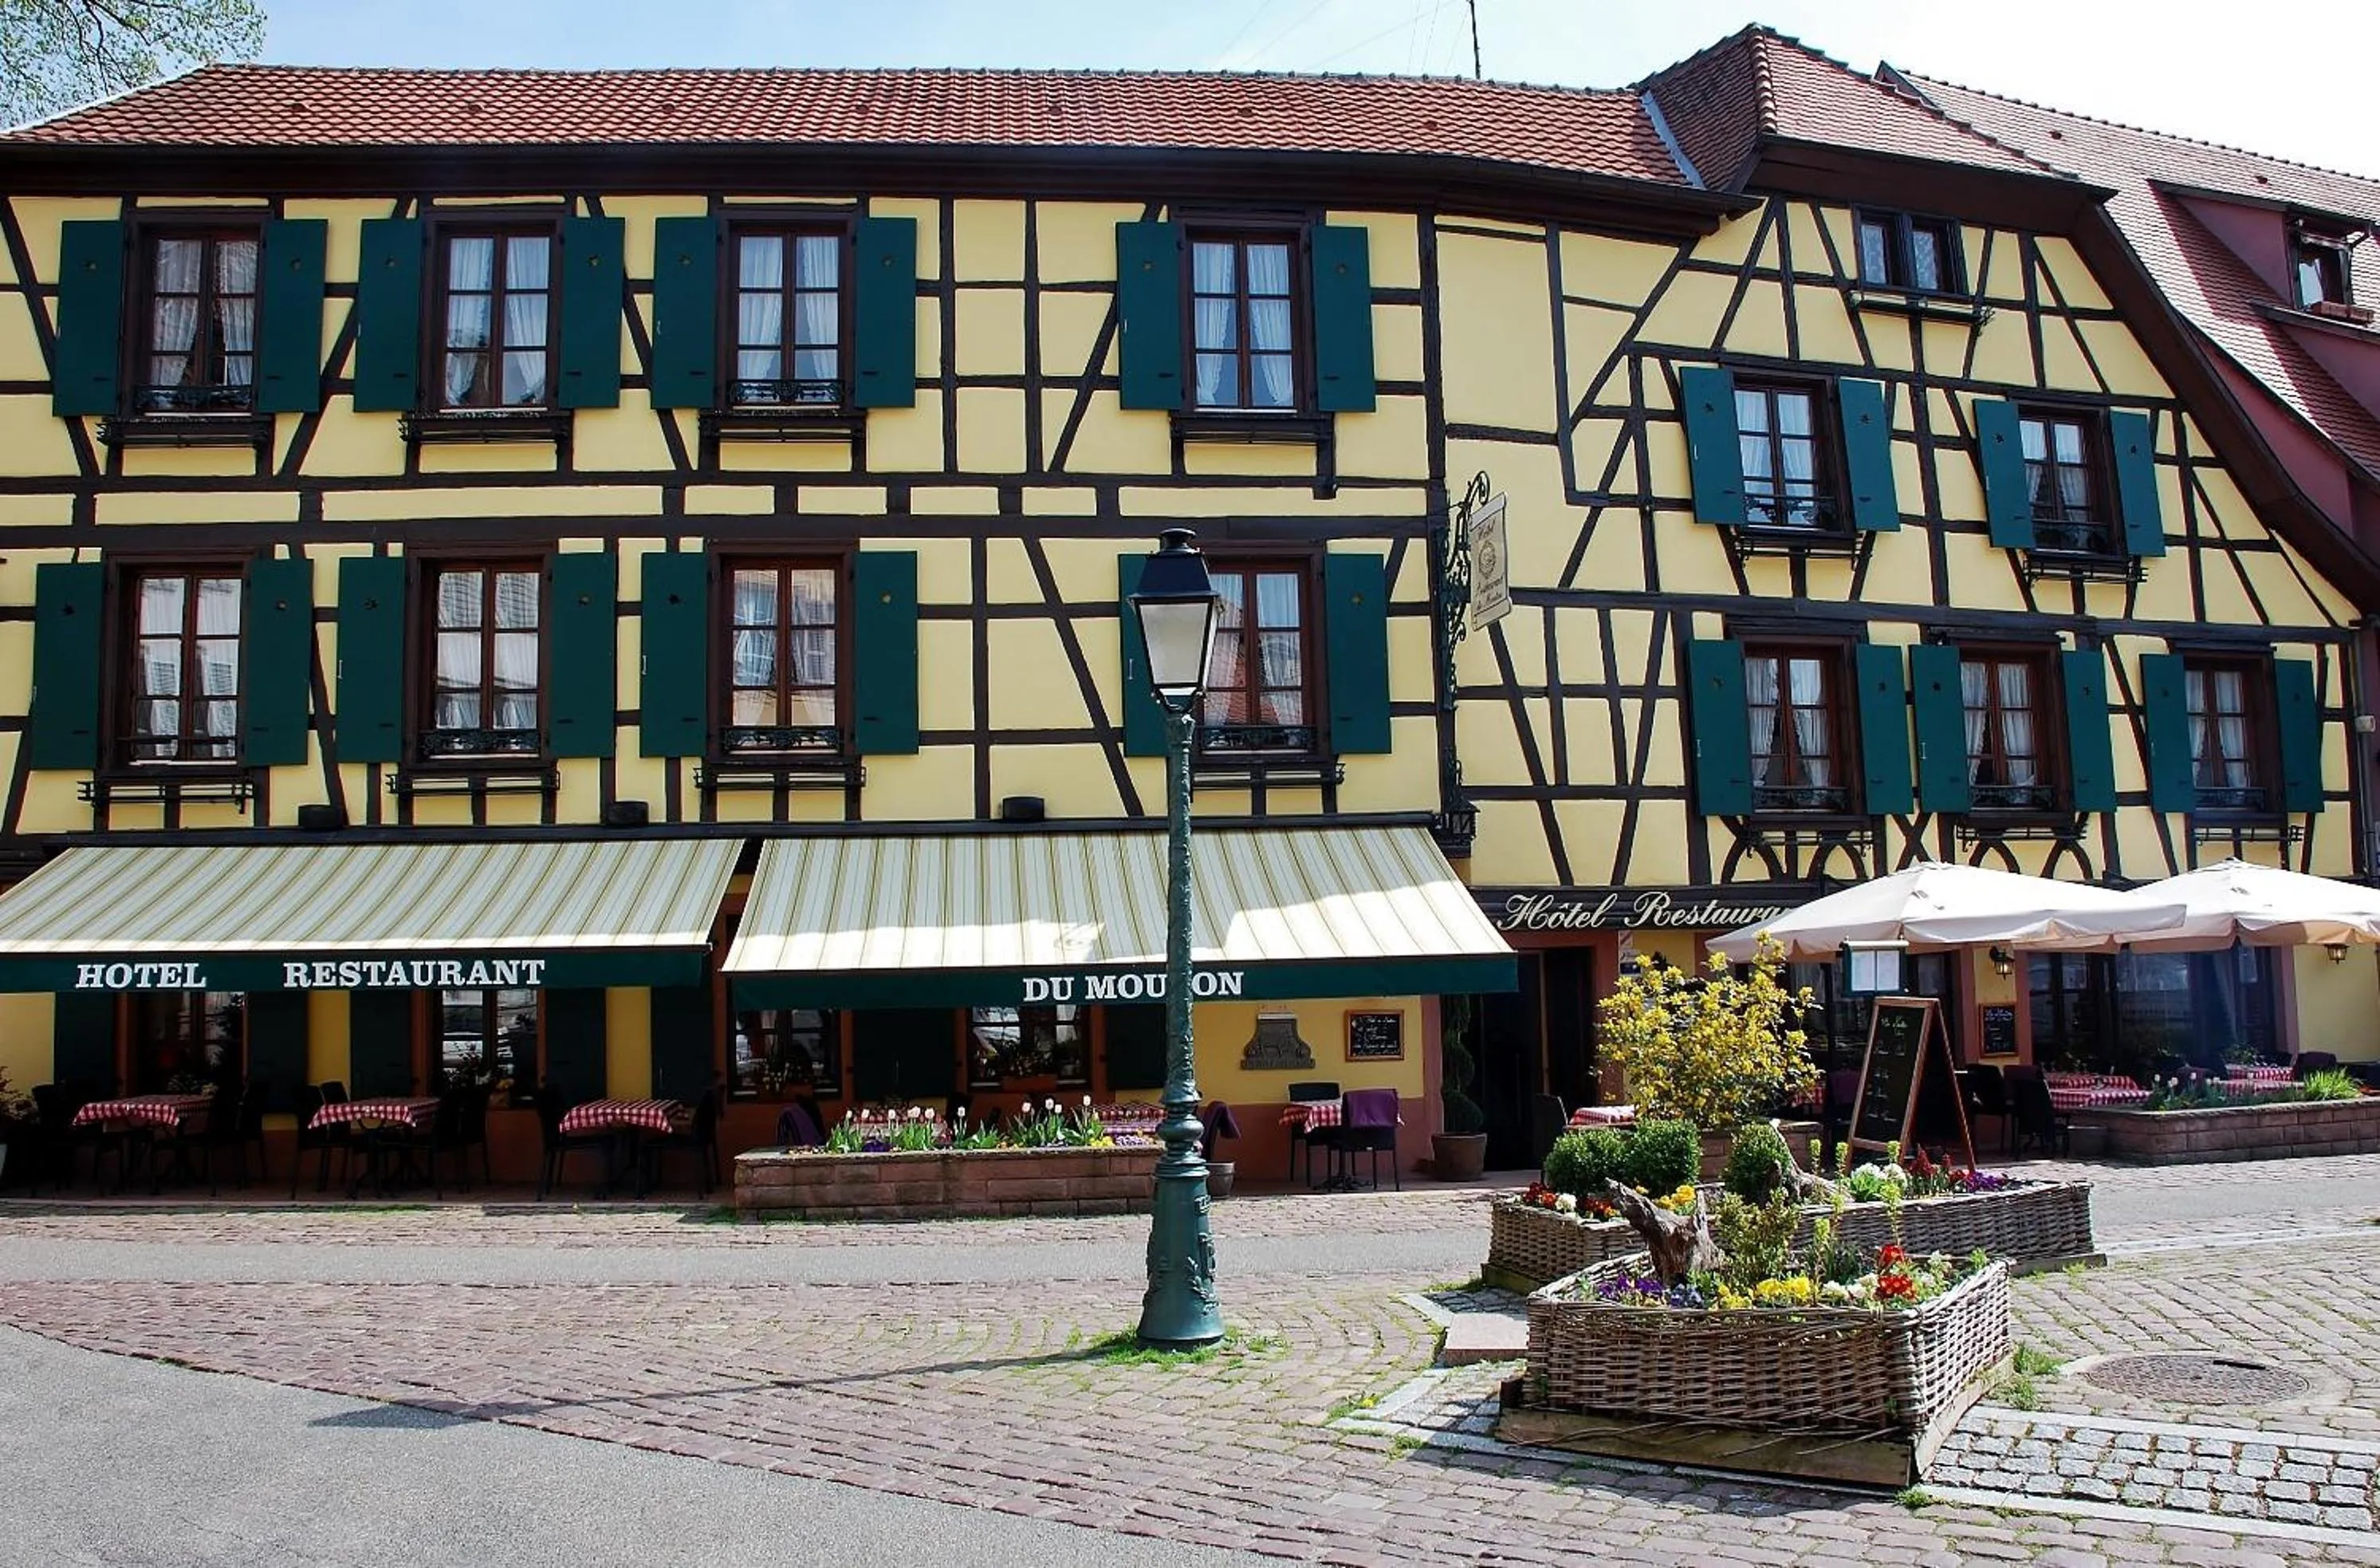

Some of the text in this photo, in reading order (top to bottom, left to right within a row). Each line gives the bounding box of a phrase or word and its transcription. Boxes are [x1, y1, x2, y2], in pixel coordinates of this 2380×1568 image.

[1497, 891, 1791, 930] Hôtel Restaura
[75, 959, 545, 988] HOTEL RESTAURANT
[1022, 971, 1245, 1002] DU MOUON
